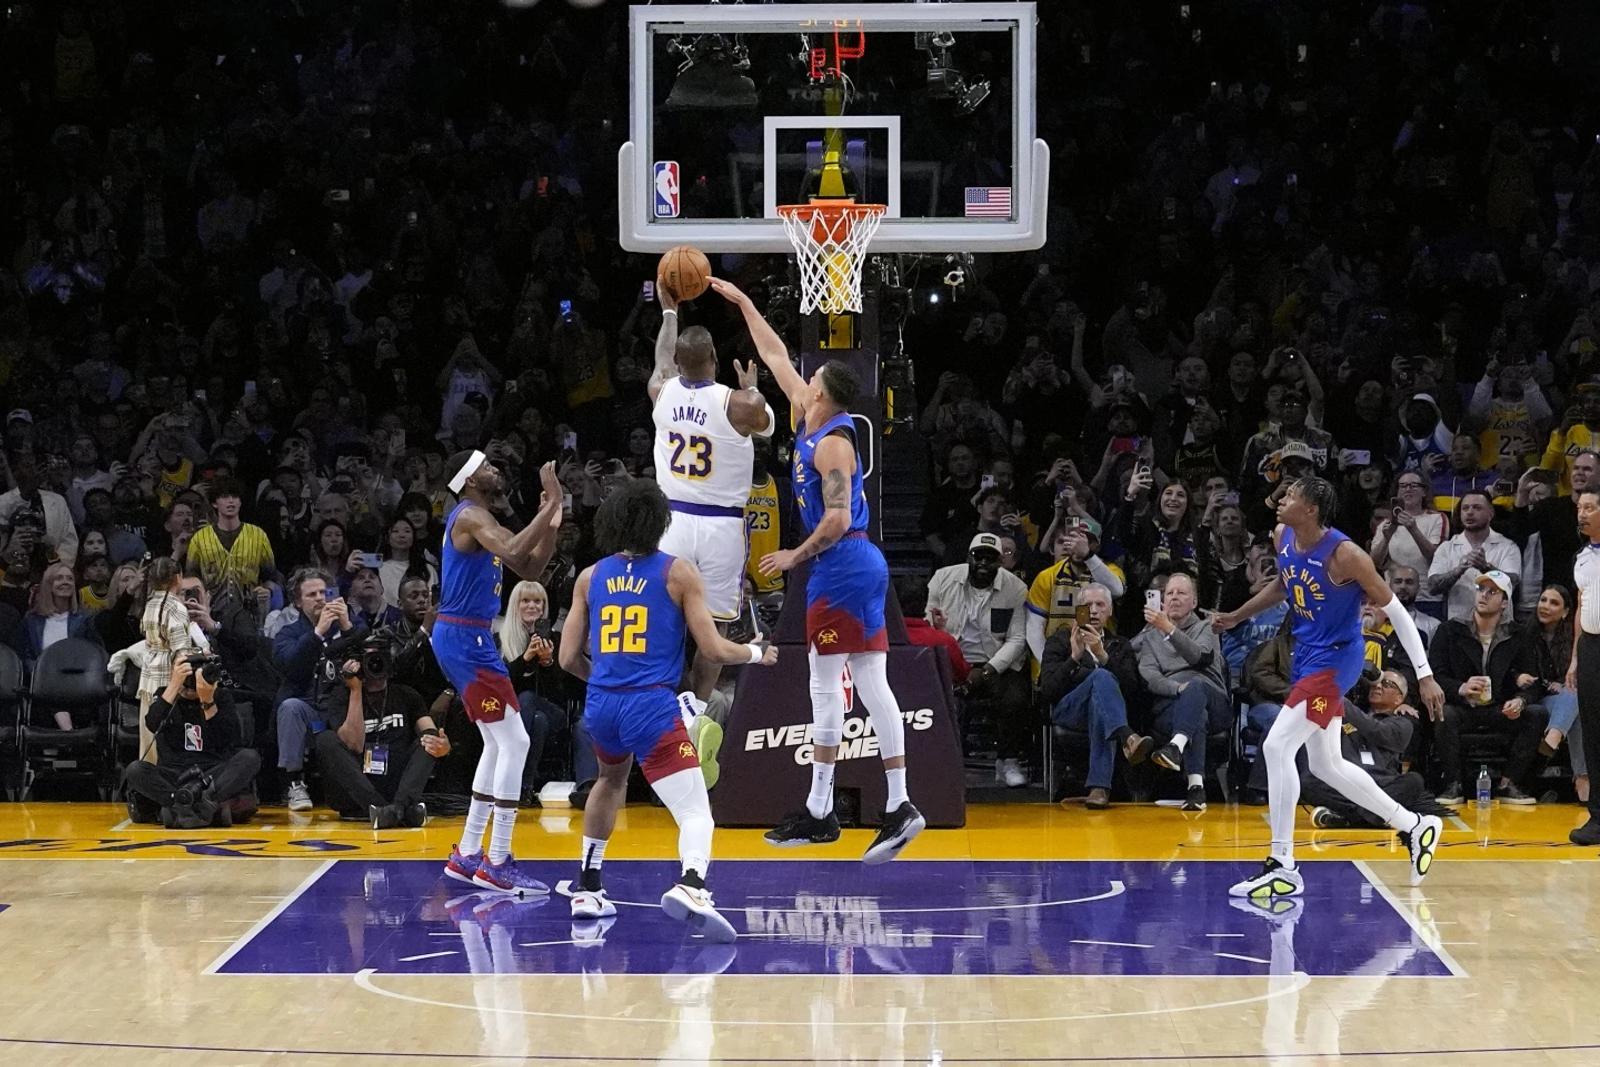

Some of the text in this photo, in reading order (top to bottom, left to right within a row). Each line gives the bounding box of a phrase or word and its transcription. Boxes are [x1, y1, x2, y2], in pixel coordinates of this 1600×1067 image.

[673, 405, 707, 426] JAMES
[667, 431, 713, 479] 23
[748, 511, 771, 531] 23
[606, 575, 648, 595] NNAJI
[1300, 568, 1326, 601] HIGH
[600, 605, 649, 654] 22
[794, 735, 880, 766] GME
